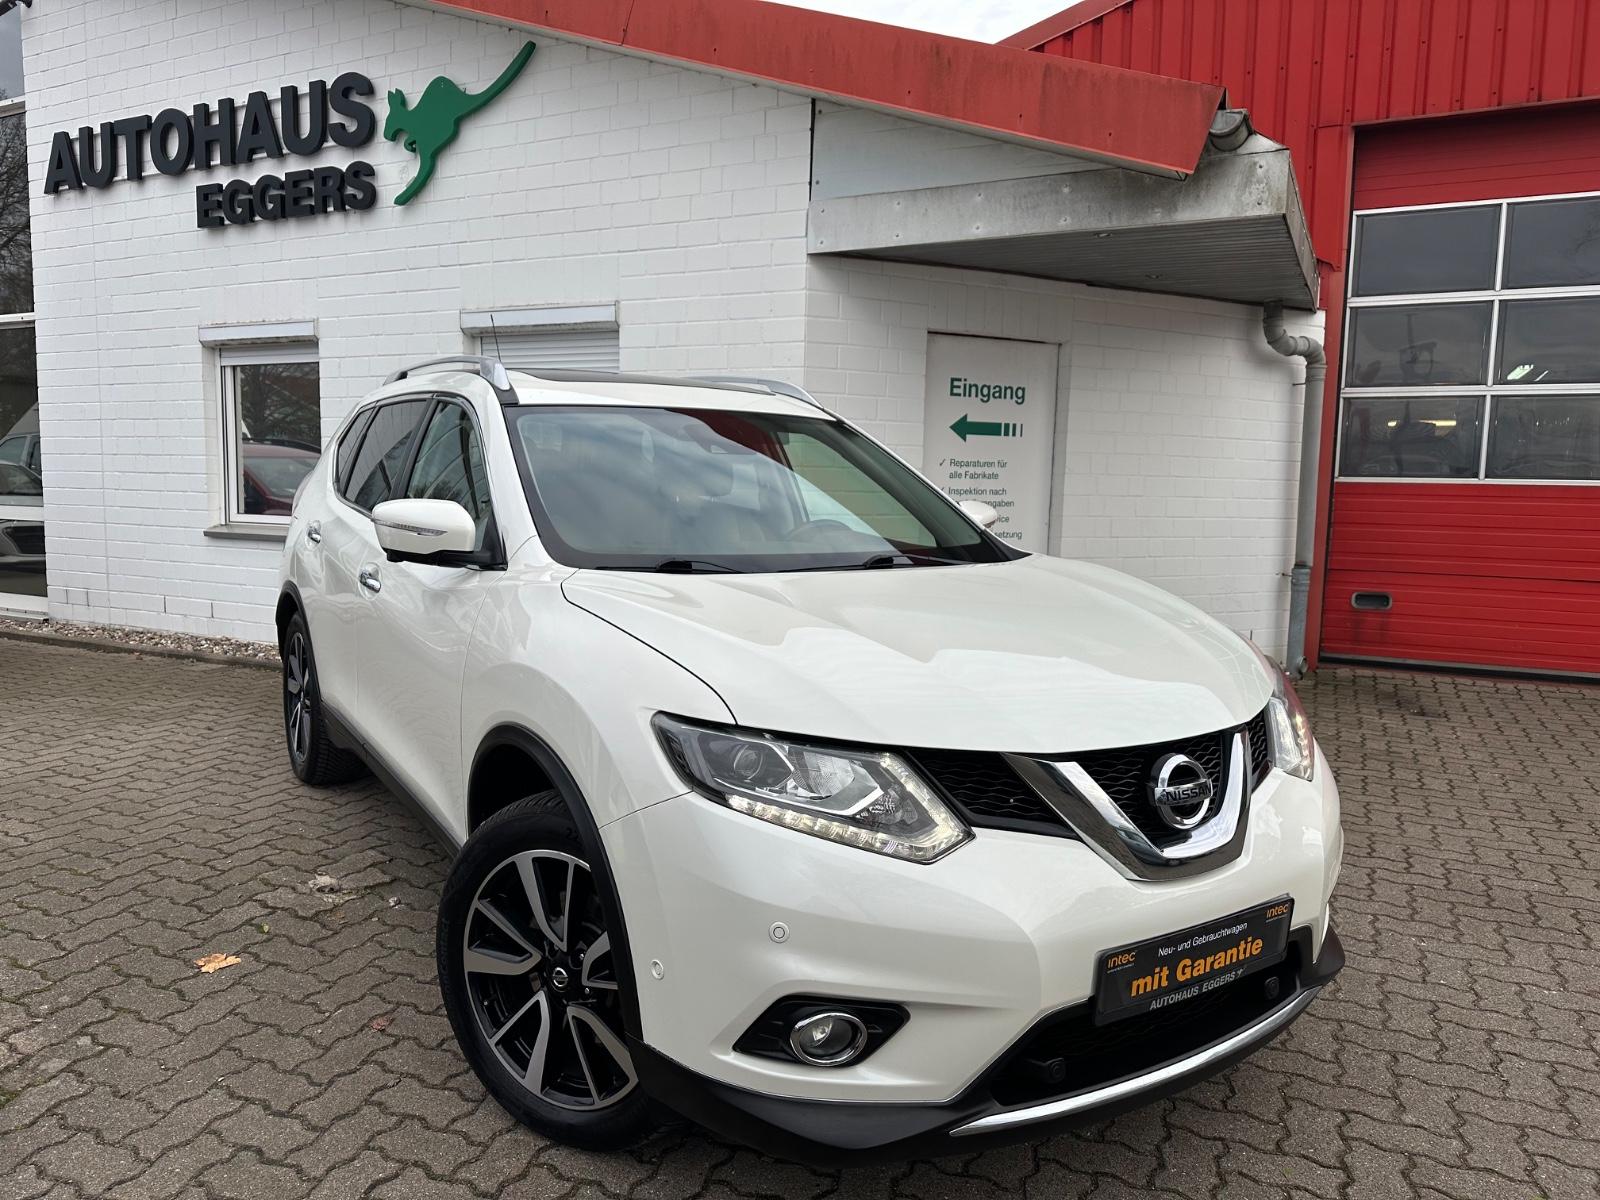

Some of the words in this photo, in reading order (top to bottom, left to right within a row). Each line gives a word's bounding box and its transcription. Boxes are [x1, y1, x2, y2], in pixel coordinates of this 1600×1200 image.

[44, 71, 375, 194] AUTOHAUS
[196, 160, 377, 228] EGGERS
[950, 377, 1026, 405] Eingang
[949, 458, 996, 469] Reparaturen
[997, 459, 1008, 468] für
[949, 470, 963, 479] alle
[964, 470, 999, 480] Fabrikate
[948, 487, 988, 497] Inspektion
[989, 487, 1007, 496] nach
[994, 530, 1023, 541] setzung
[1166, 786, 1211, 802] NISSAN
[1158, 946, 1176, 958] Neu-
[1177, 938, 1192, 952] und
[1192, 922, 1248, 946] Gebrauchtwagen
[1130, 965, 1170, 997] mit
[1176, 936, 1263, 982] Garantie
[1149, 986, 1200, 1010] AUTOHAUS
[1202, 971, 1236, 993] EGGERS
